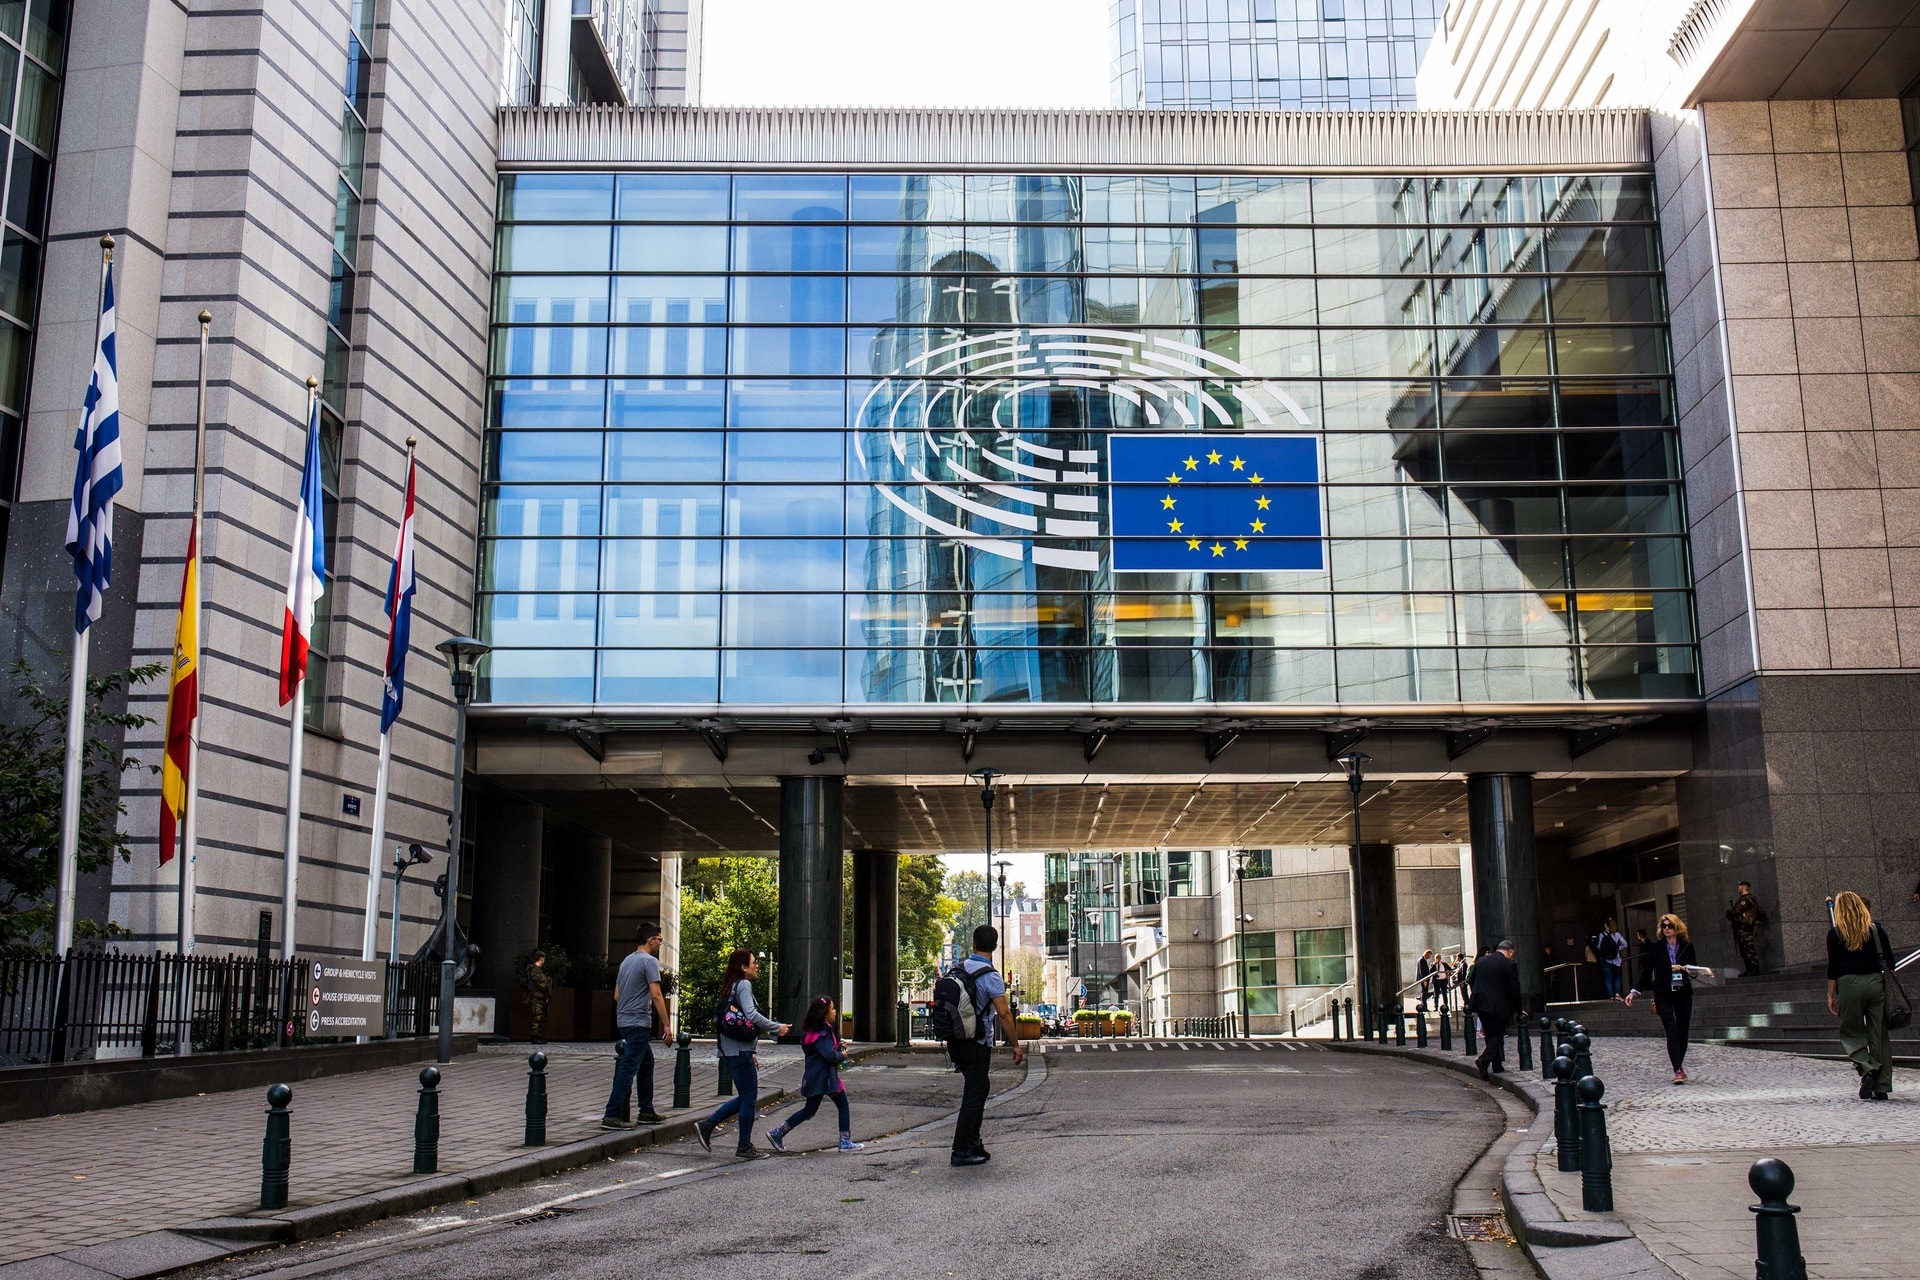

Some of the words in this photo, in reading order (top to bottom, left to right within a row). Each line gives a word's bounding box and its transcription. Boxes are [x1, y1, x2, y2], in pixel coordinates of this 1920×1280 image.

[324, 968, 339, 977] GROUP
[339, 969, 343, 978] &
[343, 969, 364, 979] HEMICYCLE
[365, 971, 376, 980] VISITS
[322, 993, 337, 1002] HOUSE
[337, 993, 344, 1002] OF
[344, 994, 365, 1003] EUROPEAN
[365, 994, 382, 1003] HISTORY
[321, 1017, 335, 1026] PRESS
[335, 1017, 366, 1026] ACCREDITATION
